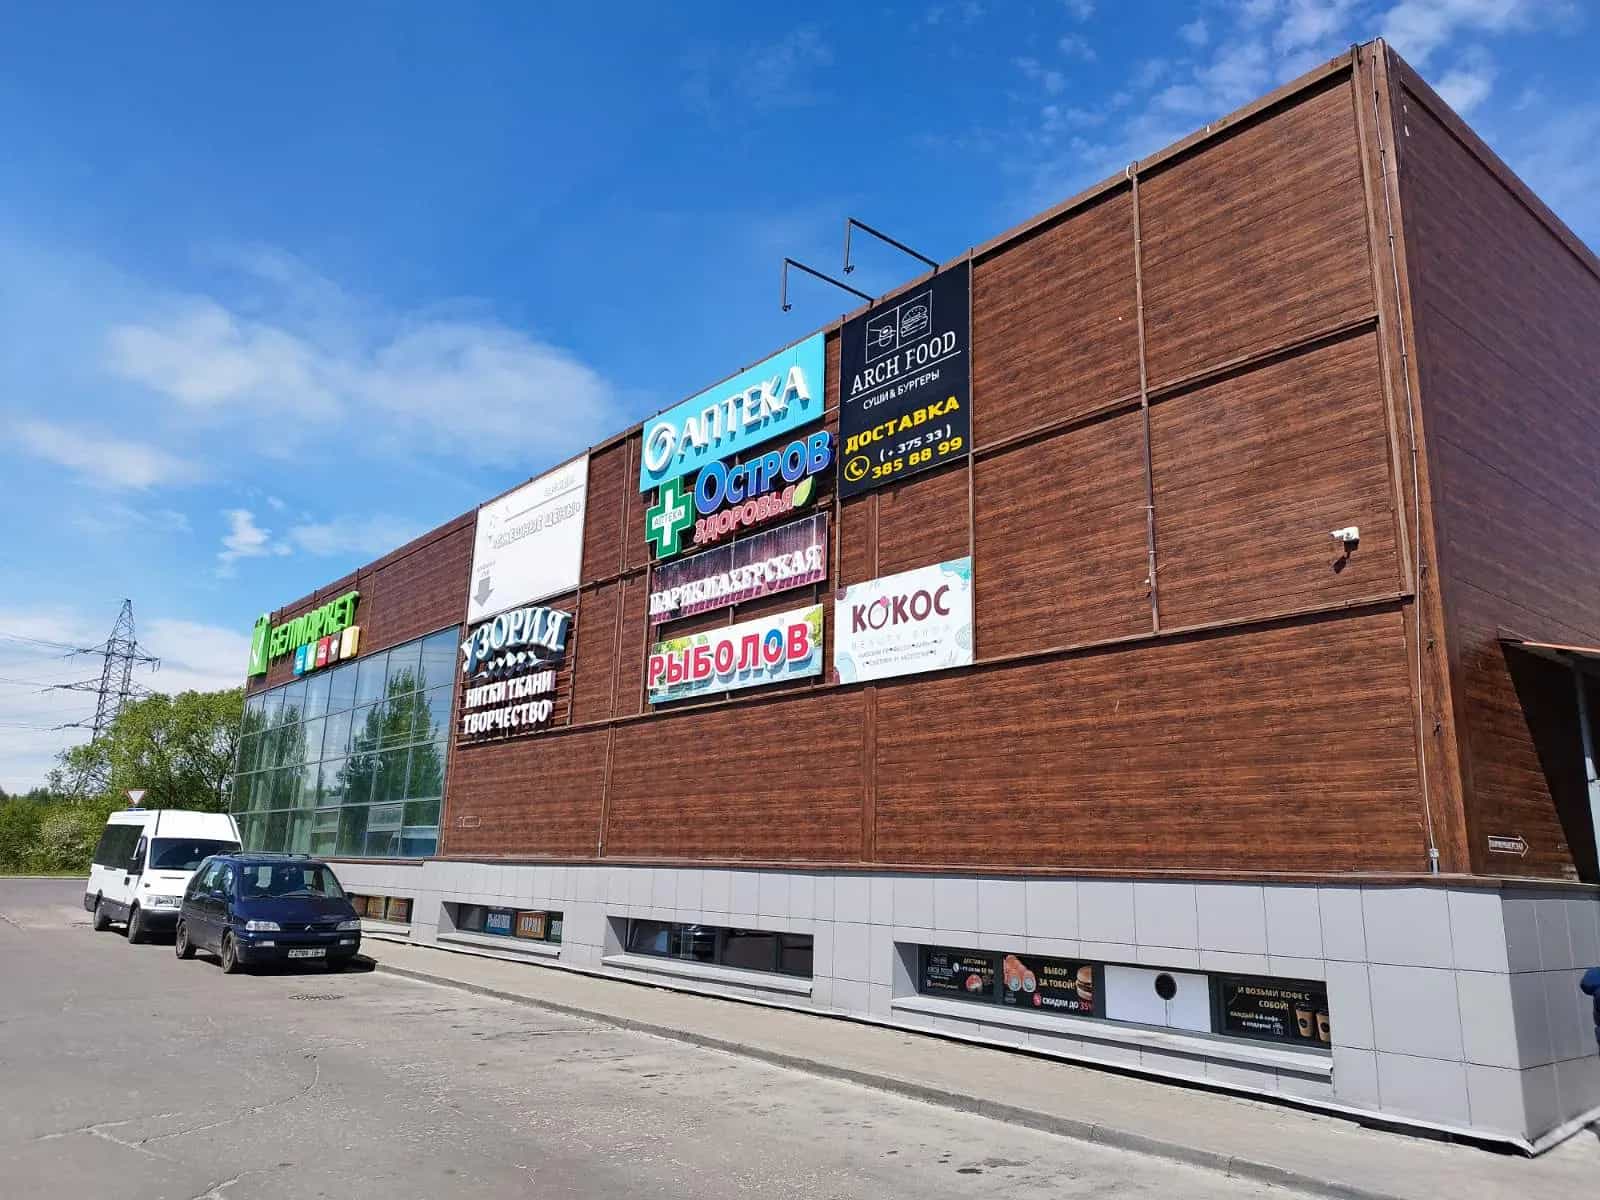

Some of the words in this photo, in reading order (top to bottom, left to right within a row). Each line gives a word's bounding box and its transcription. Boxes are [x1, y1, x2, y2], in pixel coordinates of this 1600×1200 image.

[850, 358, 900, 396] ARCH
[905, 331, 956, 371] FOOD
[863, 392, 889, 410] СУШИ
[897, 369, 940, 396] БУРГЕРЫ
[677, 366, 811, 457] АПТЕКА
[845, 395, 960, 454] ДОСТАВКА
[694, 430, 834, 515] ОСТРОВ
[871, 459, 904, 480] 385
[909, 448, 932, 467] 88
[938, 436, 963, 455] 99
[654, 509, 683, 526] АПТЕКА
[693, 485, 795, 543] ЗДОРОВЬЯ
[649, 545, 823, 615] ПАРИКМАХЕРСКАЯ
[852, 584, 950, 634] КОКОС
[269, 591, 360, 660] БЕЛМАРКЕТ
[460, 607, 572, 673] УЗОРИЯ
[648, 622, 810, 687] РЫБОЛОВ
[463, 699, 553, 735] ТВОРЧЕСТВО
[465, 680, 507, 709] НИТКИ
[507, 670, 557, 699] ТКАНИ
[1043, 966, 1068, 977] ВЫБОР
